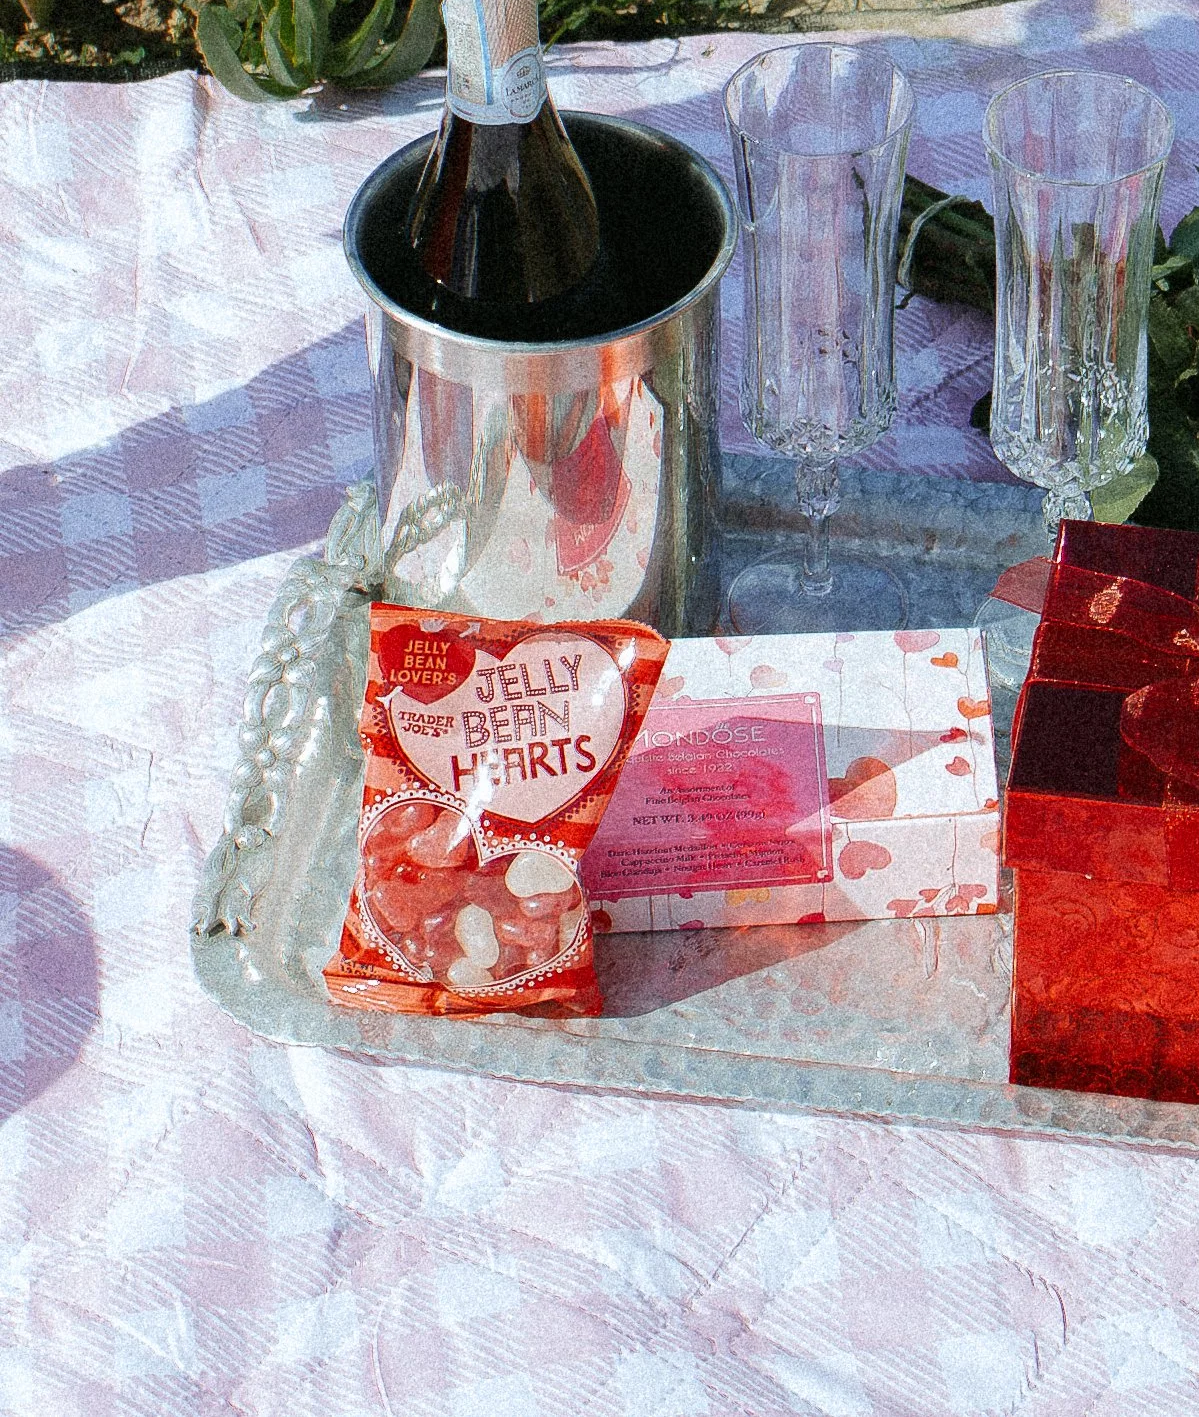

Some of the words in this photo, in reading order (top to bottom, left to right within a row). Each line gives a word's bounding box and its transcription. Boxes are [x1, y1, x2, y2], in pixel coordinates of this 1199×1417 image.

[403, 640, 451, 655] JELLY
[403, 655, 447, 670] BEAN
[389, 669, 457, 685] LOVER'S
[476, 654, 582, 703] JELLY
[398, 711, 455, 728] TRADER
[461, 700, 570, 749] BEAN
[633, 815, 658, 825] NET
[660, 813, 684, 824] WT.
